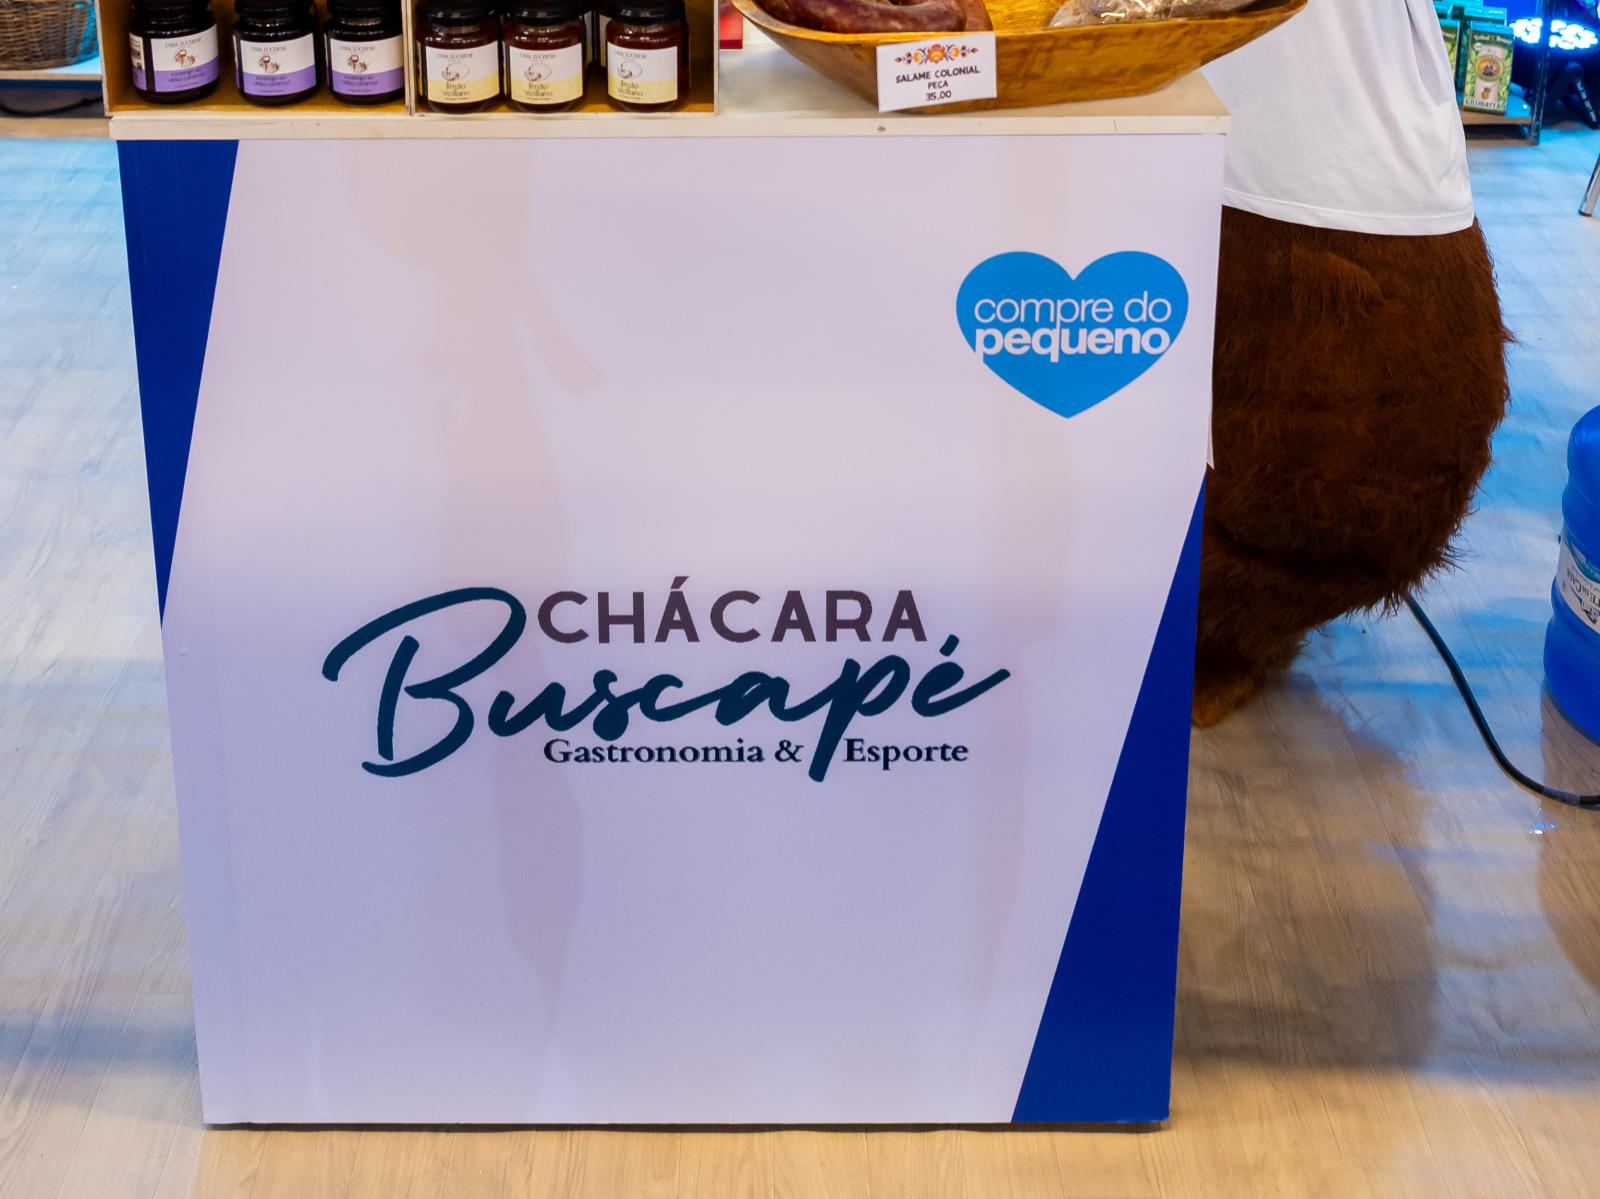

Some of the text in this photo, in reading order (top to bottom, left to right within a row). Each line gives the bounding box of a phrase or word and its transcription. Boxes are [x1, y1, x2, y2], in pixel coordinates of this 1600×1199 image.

[896, 65, 980, 84] SALAME COLONIAL
[925, 90, 952, 102] 35,00
[974, 290, 1172, 326] compre do
[974, 327, 1171, 363] pequeno
[537, 575, 928, 644] CHÁCARA
[321, 586, 1011, 783] Buscapé
[544, 737, 969, 771] Gastronomia & Esporte
